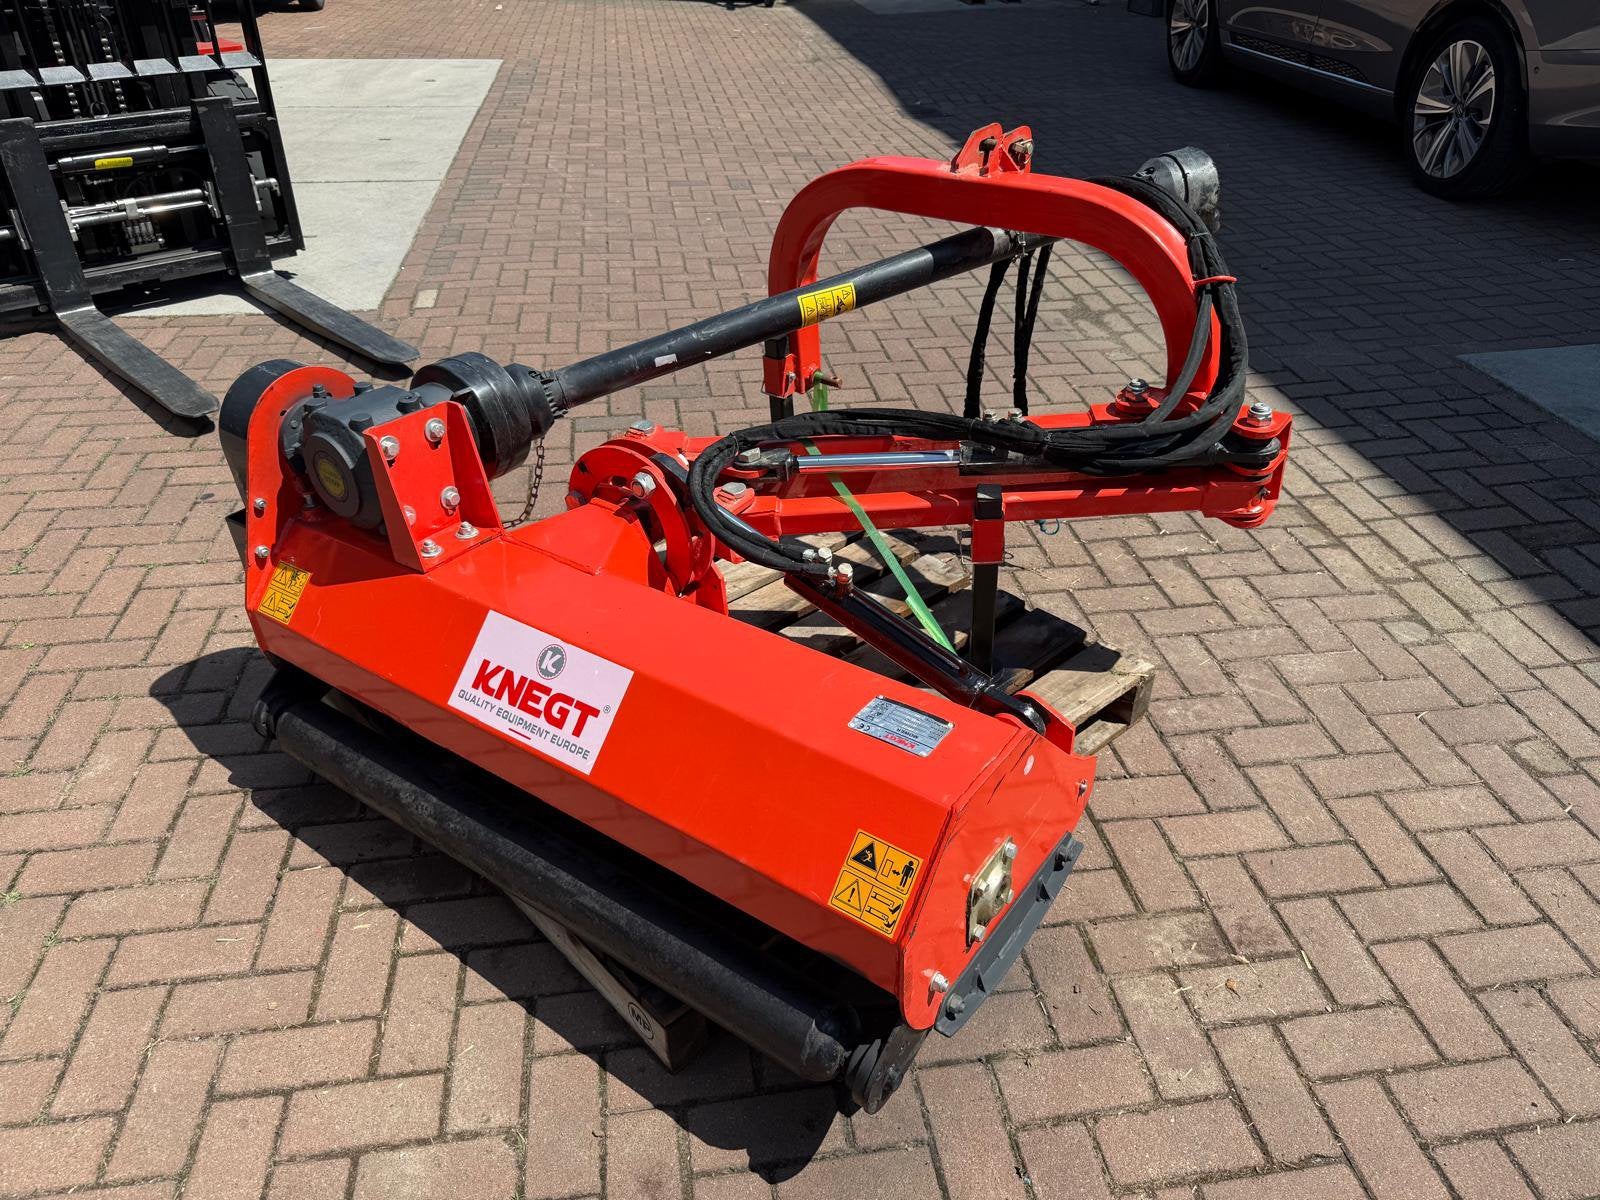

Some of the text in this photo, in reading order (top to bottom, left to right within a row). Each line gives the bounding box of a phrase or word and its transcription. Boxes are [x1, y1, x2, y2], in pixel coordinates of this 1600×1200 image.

[541, 650, 562, 673] K
[472, 659, 601, 738] KNEGT
[458, 689, 590, 760] QUALITY EQUIPMENT EUROPE
[885, 734, 916, 749] KNEGT
